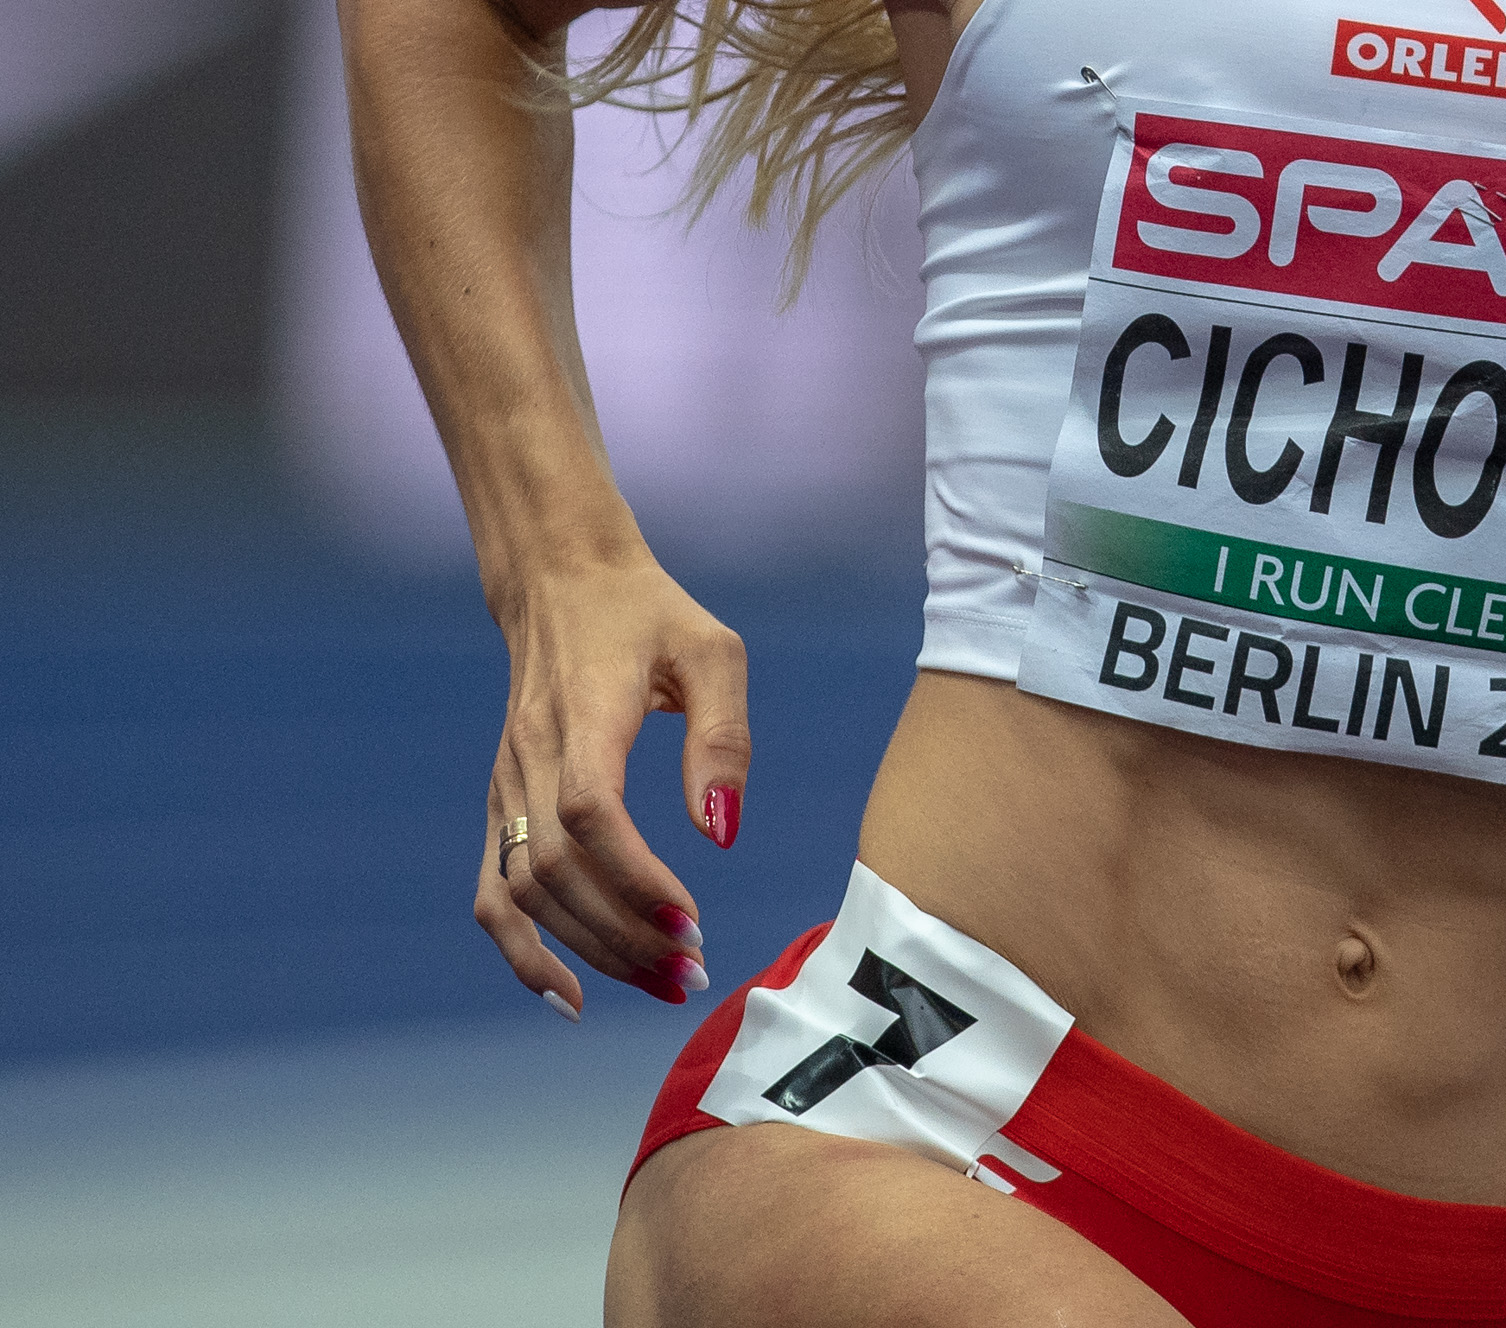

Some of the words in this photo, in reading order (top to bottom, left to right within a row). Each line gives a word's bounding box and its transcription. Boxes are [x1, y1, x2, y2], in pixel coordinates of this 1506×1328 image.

[1213, 546, 1229, 591] I
[1250, 554, 1385, 622] RUN
[1098, 602, 1450, 749] BERLIN
[761, 947, 978, 1117] 7
